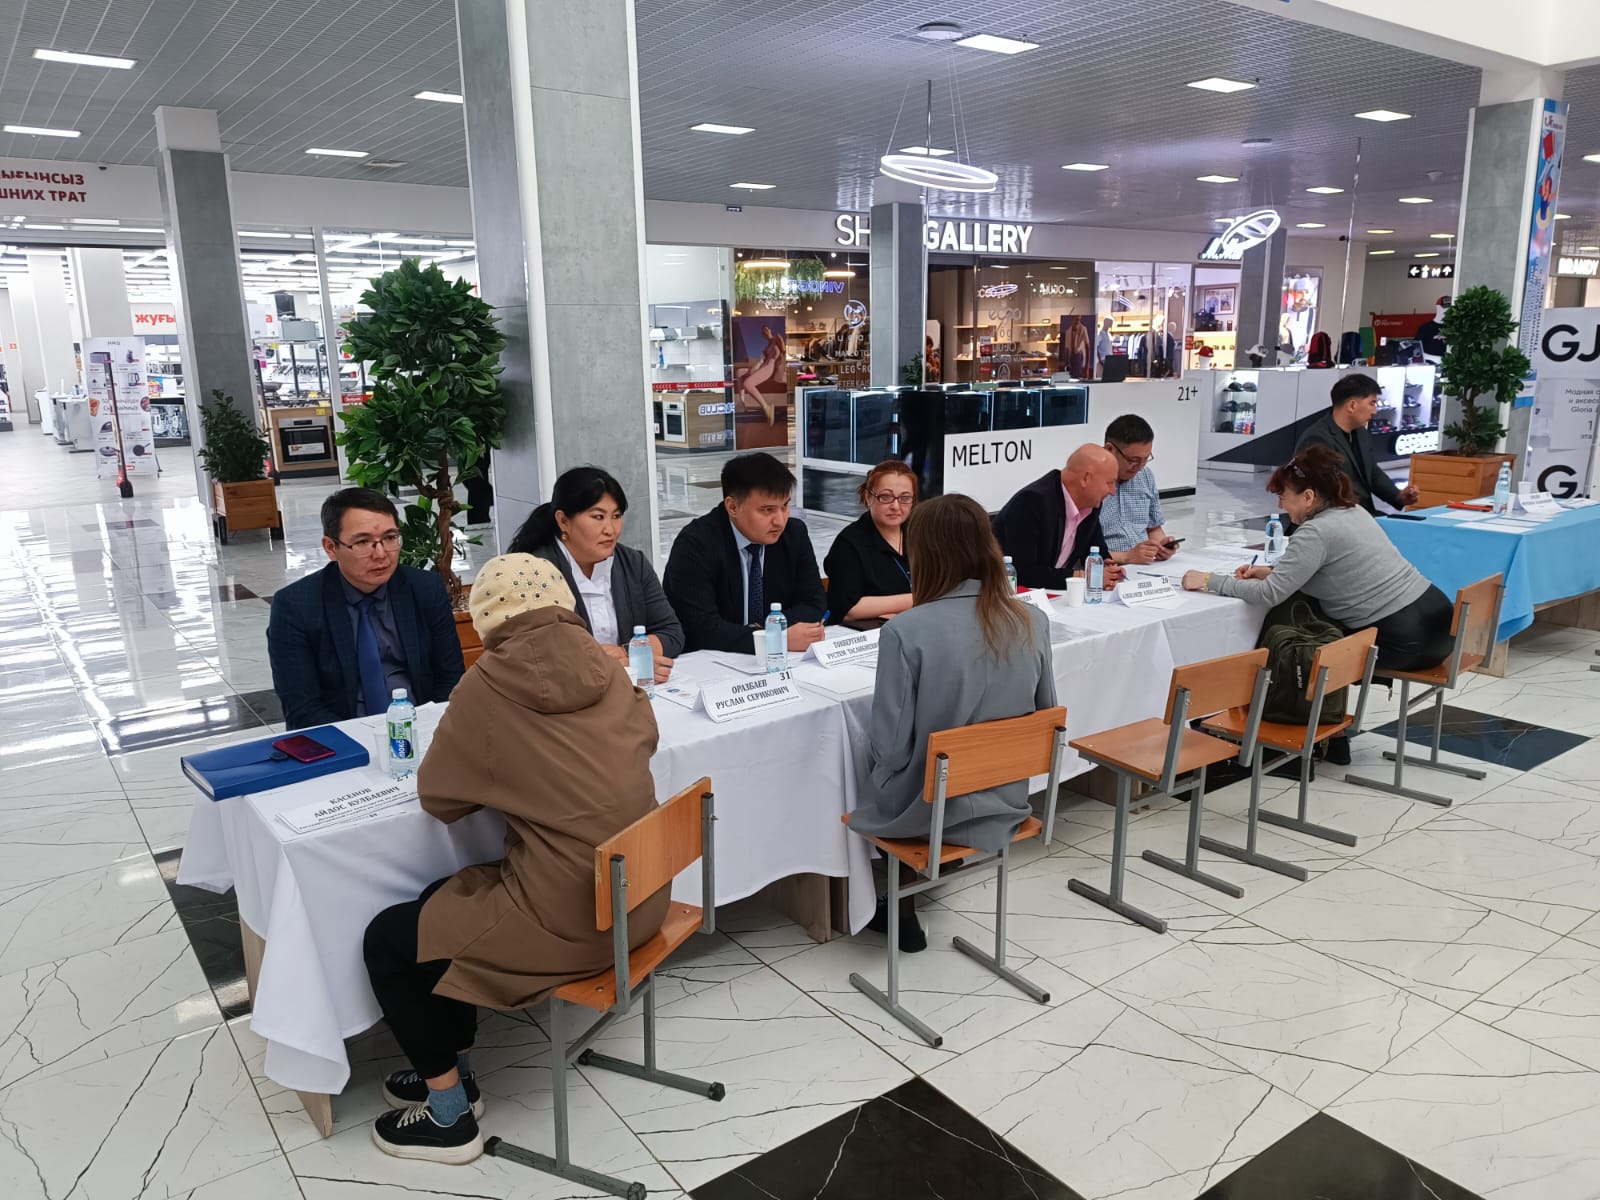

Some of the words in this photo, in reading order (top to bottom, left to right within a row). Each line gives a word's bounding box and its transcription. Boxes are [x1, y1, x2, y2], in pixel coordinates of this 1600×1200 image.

[0, 187, 46, 201] ШНИХ
[48, 190, 87, 203] ТРАТ
[923, 220, 1033, 253] GALLERY
[135, 314, 177, 326] жуғы
[1177, 385, 1199, 401] 21+
[952, 439, 1032, 468] MELTON
[780, 671, 791, 681] 31
[731, 679, 768, 695] ОРАЗБАЕВ
[715, 694, 746, 710] РУСЛАН
[746, 685, 790, 703] СЕРИКОВИЧ
